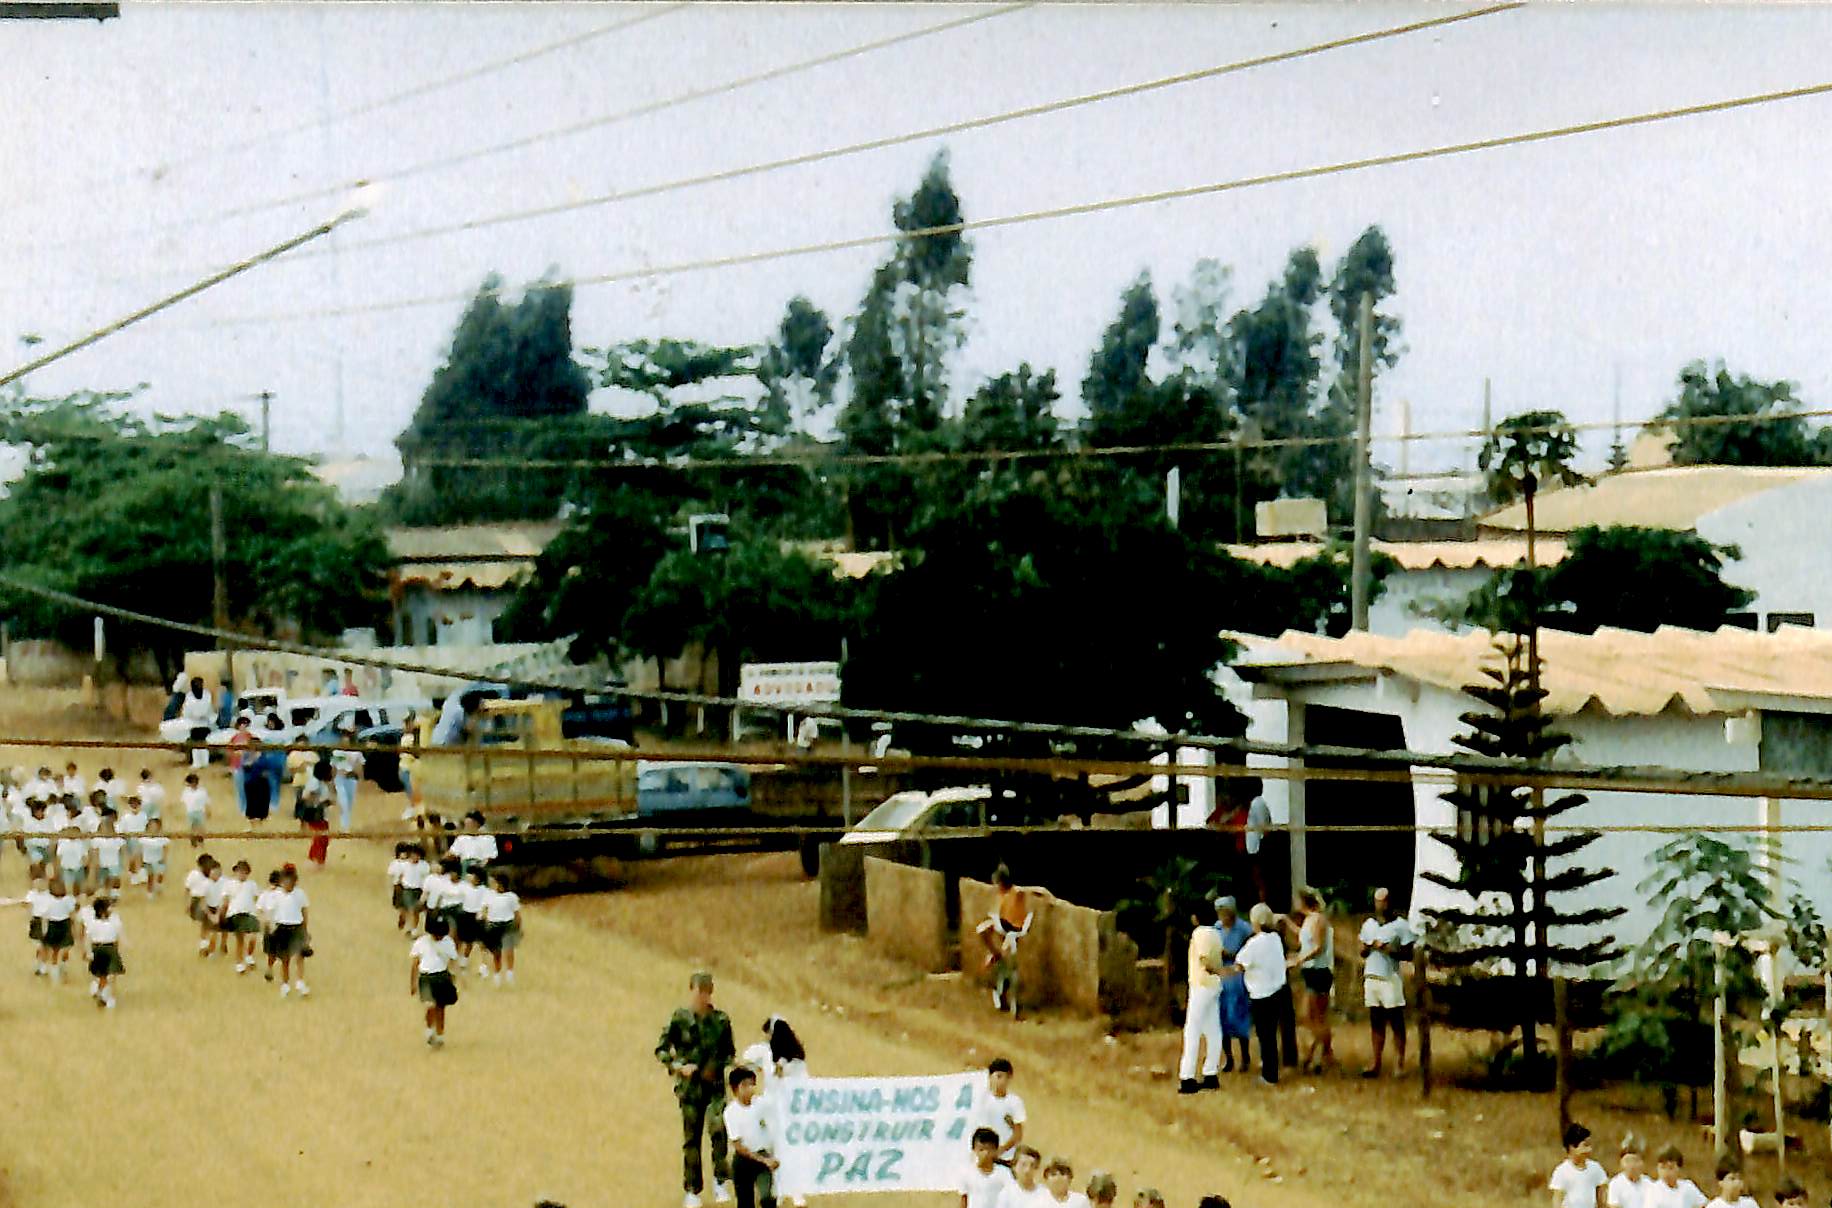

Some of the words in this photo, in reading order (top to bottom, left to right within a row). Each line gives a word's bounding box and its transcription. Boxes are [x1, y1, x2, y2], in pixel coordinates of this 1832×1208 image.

[956, 1084, 973, 1110] A
[785, 1118, 935, 1144] CONSTRUIR
[947, 1117, 966, 1140] A
[817, 1148, 904, 1182] PAZ
